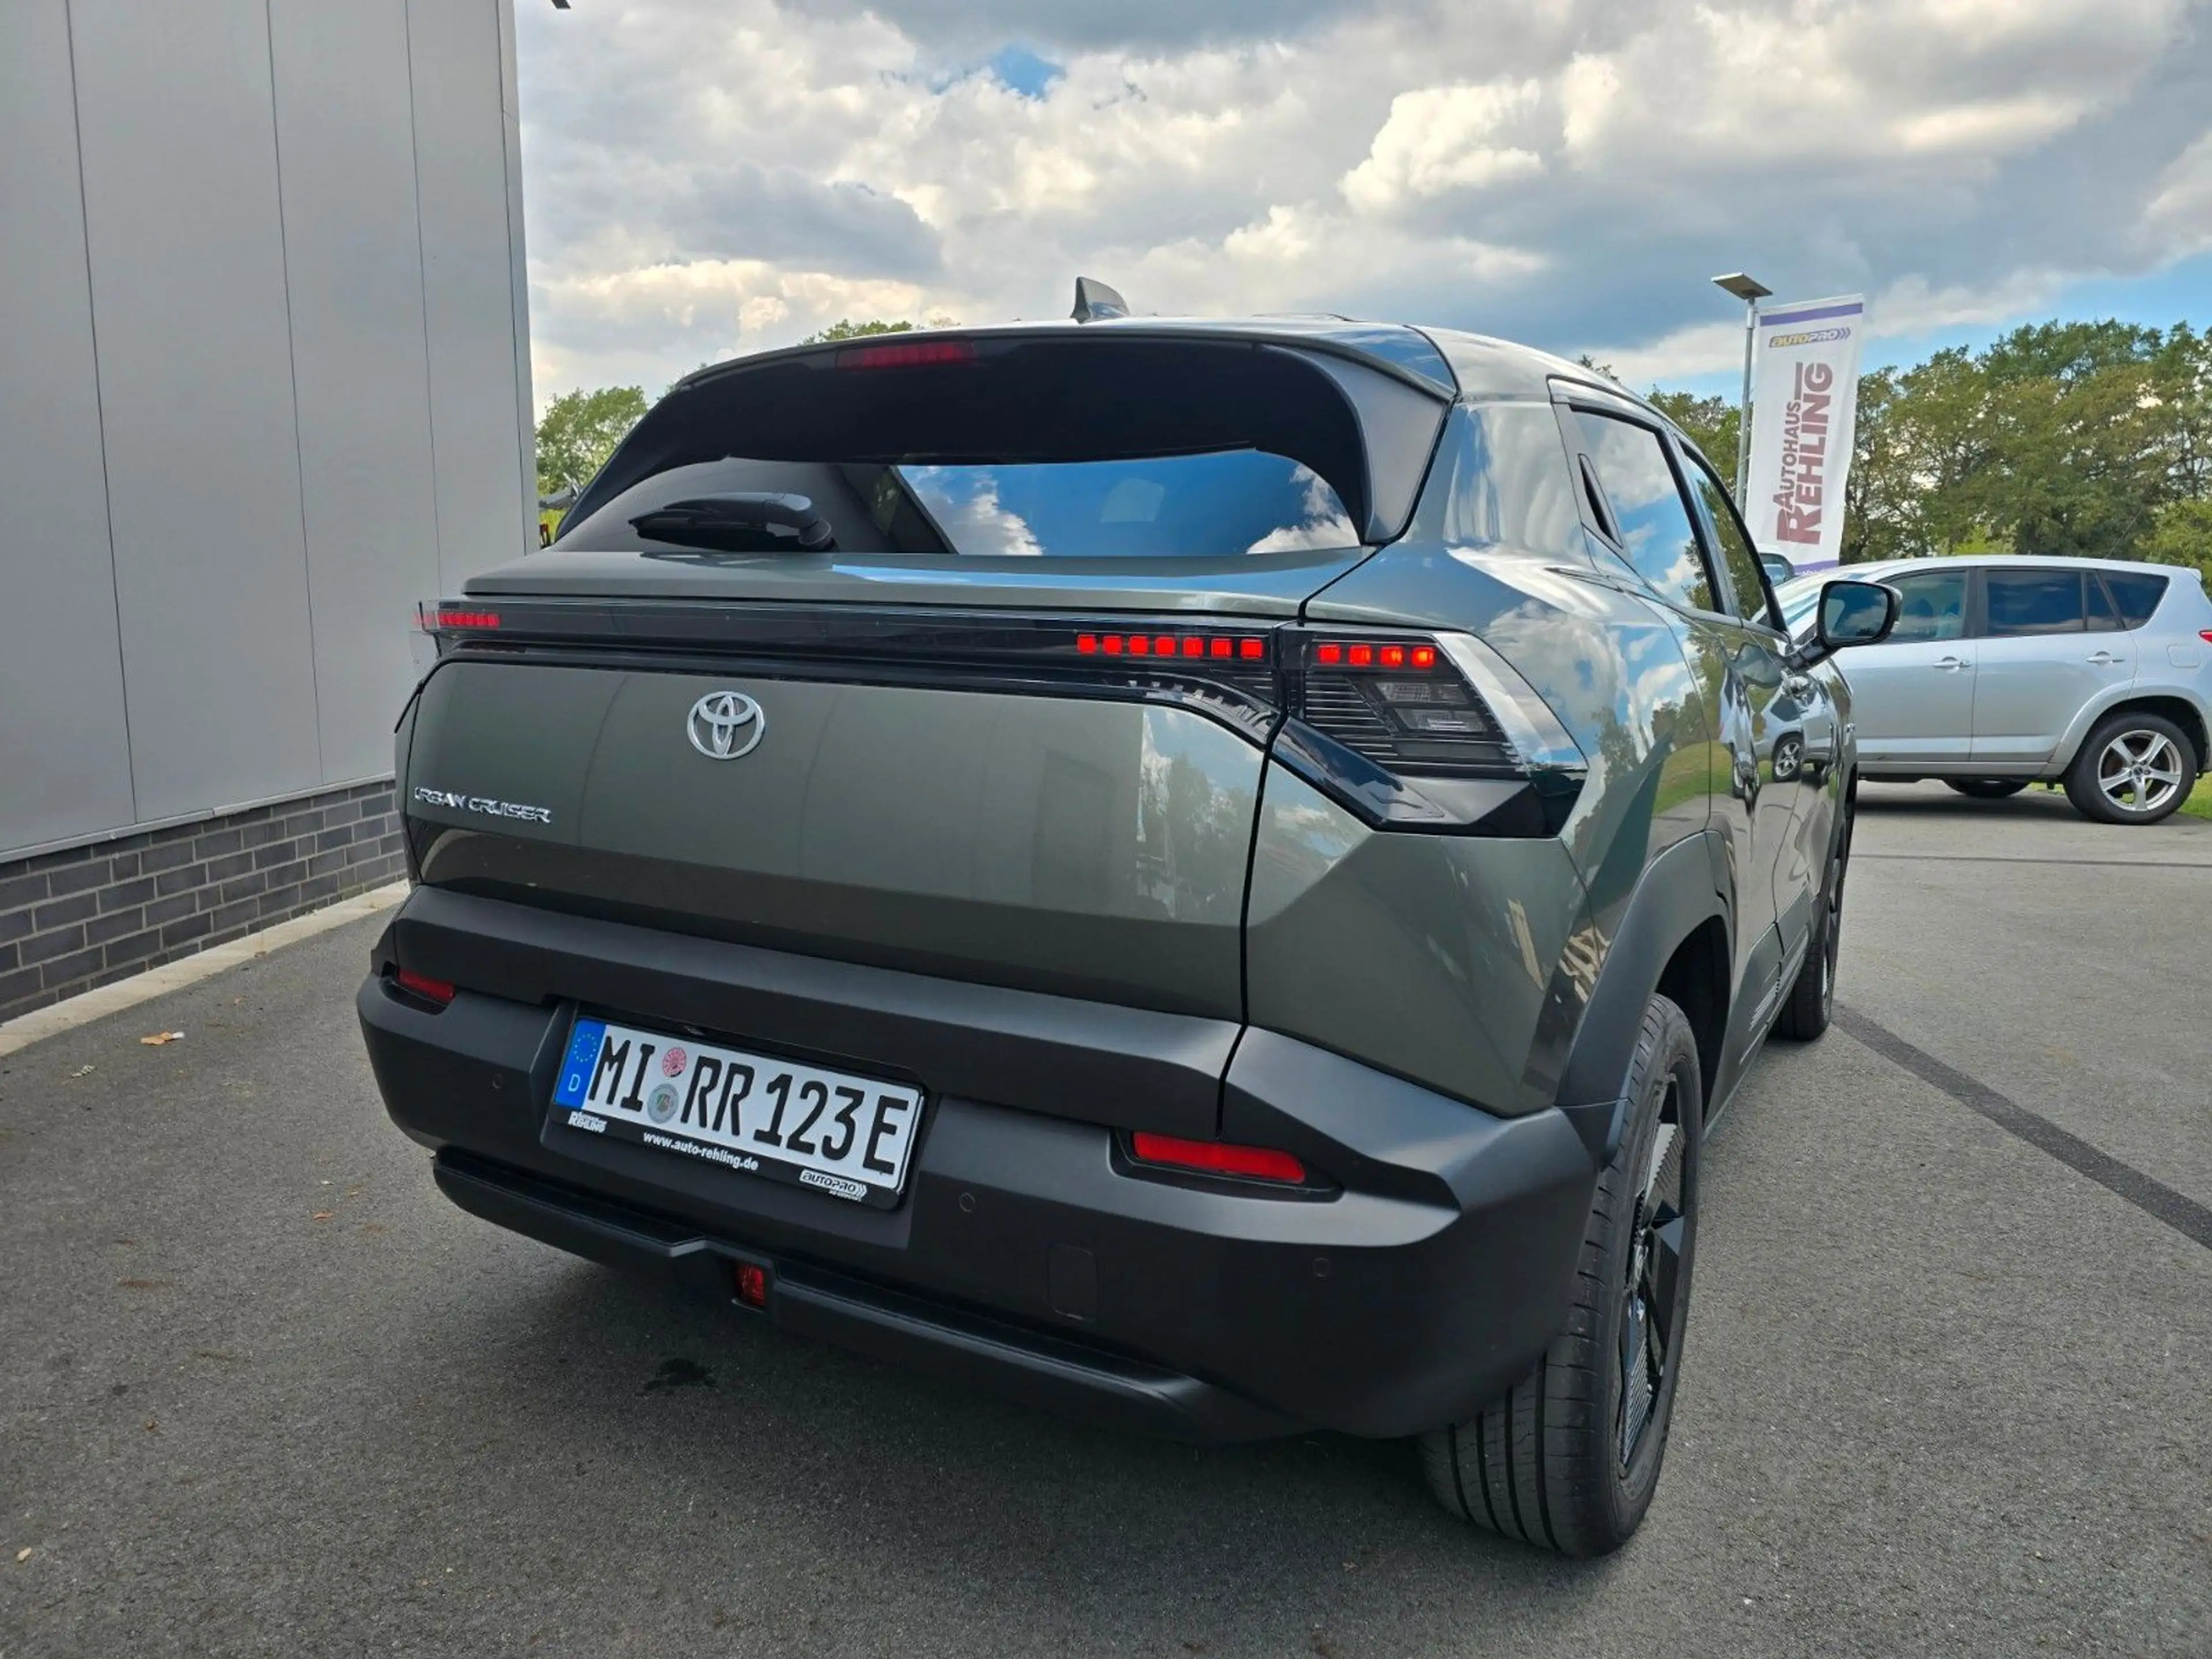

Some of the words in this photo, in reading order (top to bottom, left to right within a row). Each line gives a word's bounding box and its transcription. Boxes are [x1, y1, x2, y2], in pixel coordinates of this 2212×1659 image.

[1773, 400, 1801, 513] AUTOHAUS
[1777, 363, 1834, 545] REHLING
[468, 797, 551, 824] CRUISER
[567, 1073, 581, 1093] D
[587, 1035, 656, 1113] MI
[680, 1055, 755, 1137] RR
[753, 1073, 910, 1175] 123E
[643, 1131, 759, 1171] www.auto-rehling.de
